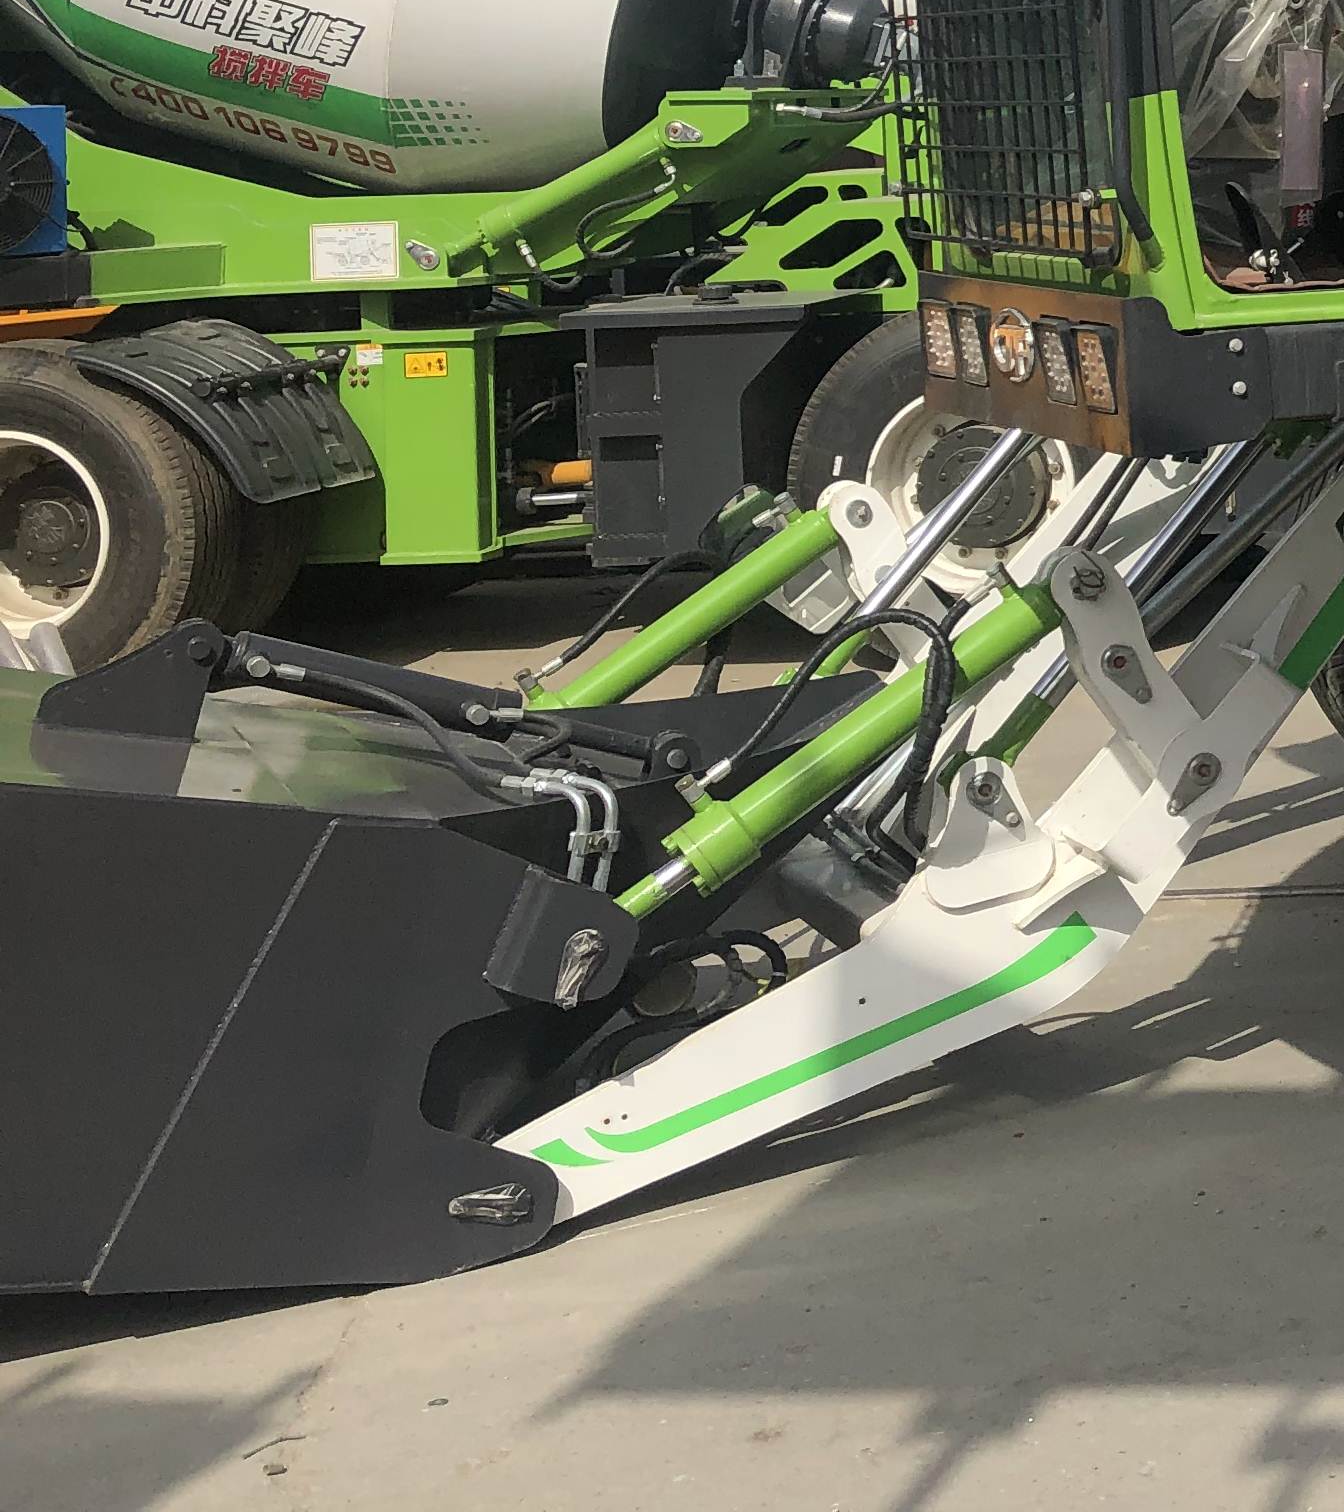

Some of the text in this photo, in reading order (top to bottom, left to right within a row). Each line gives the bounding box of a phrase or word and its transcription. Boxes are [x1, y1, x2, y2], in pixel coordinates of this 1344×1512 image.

[208, 44, 331, 102] 搅拌车
[130, 84, 398, 175] 400 106 9799
